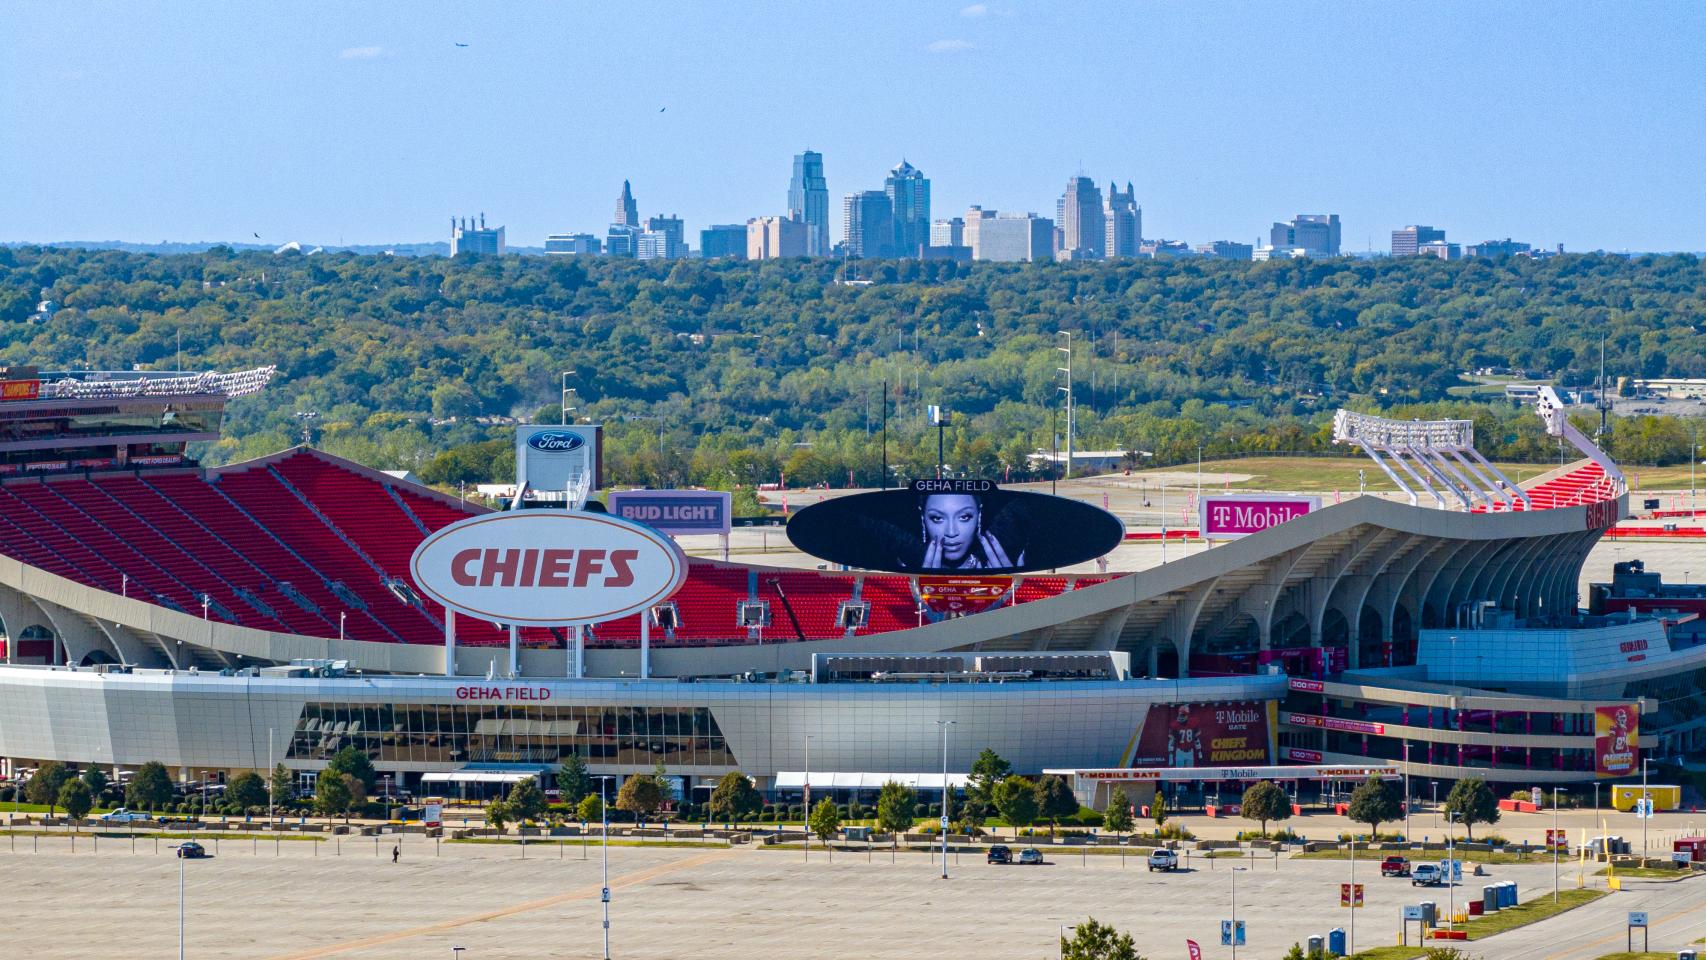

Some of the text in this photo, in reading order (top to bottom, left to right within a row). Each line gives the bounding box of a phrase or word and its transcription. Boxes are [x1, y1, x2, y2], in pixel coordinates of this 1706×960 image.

[538, 433, 573, 449] Ford
[916, 480, 991, 491] GEHA FIELD
[622, 506, 717, 520] BUD LIGHT
[1234, 506, 1302, 528] Mobil
[451, 548, 639, 588] CHIEFS
[456, 686, 551, 700] GEHA FIELD
[1226, 709, 1260, 723] Mobile
[1179, 729, 1193, 744] 78
[1211, 737, 1248, 750] CHIEFS
[1211, 749, 1265, 762] KINGDOM
[1230, 768, 1258, 778] Mobile
